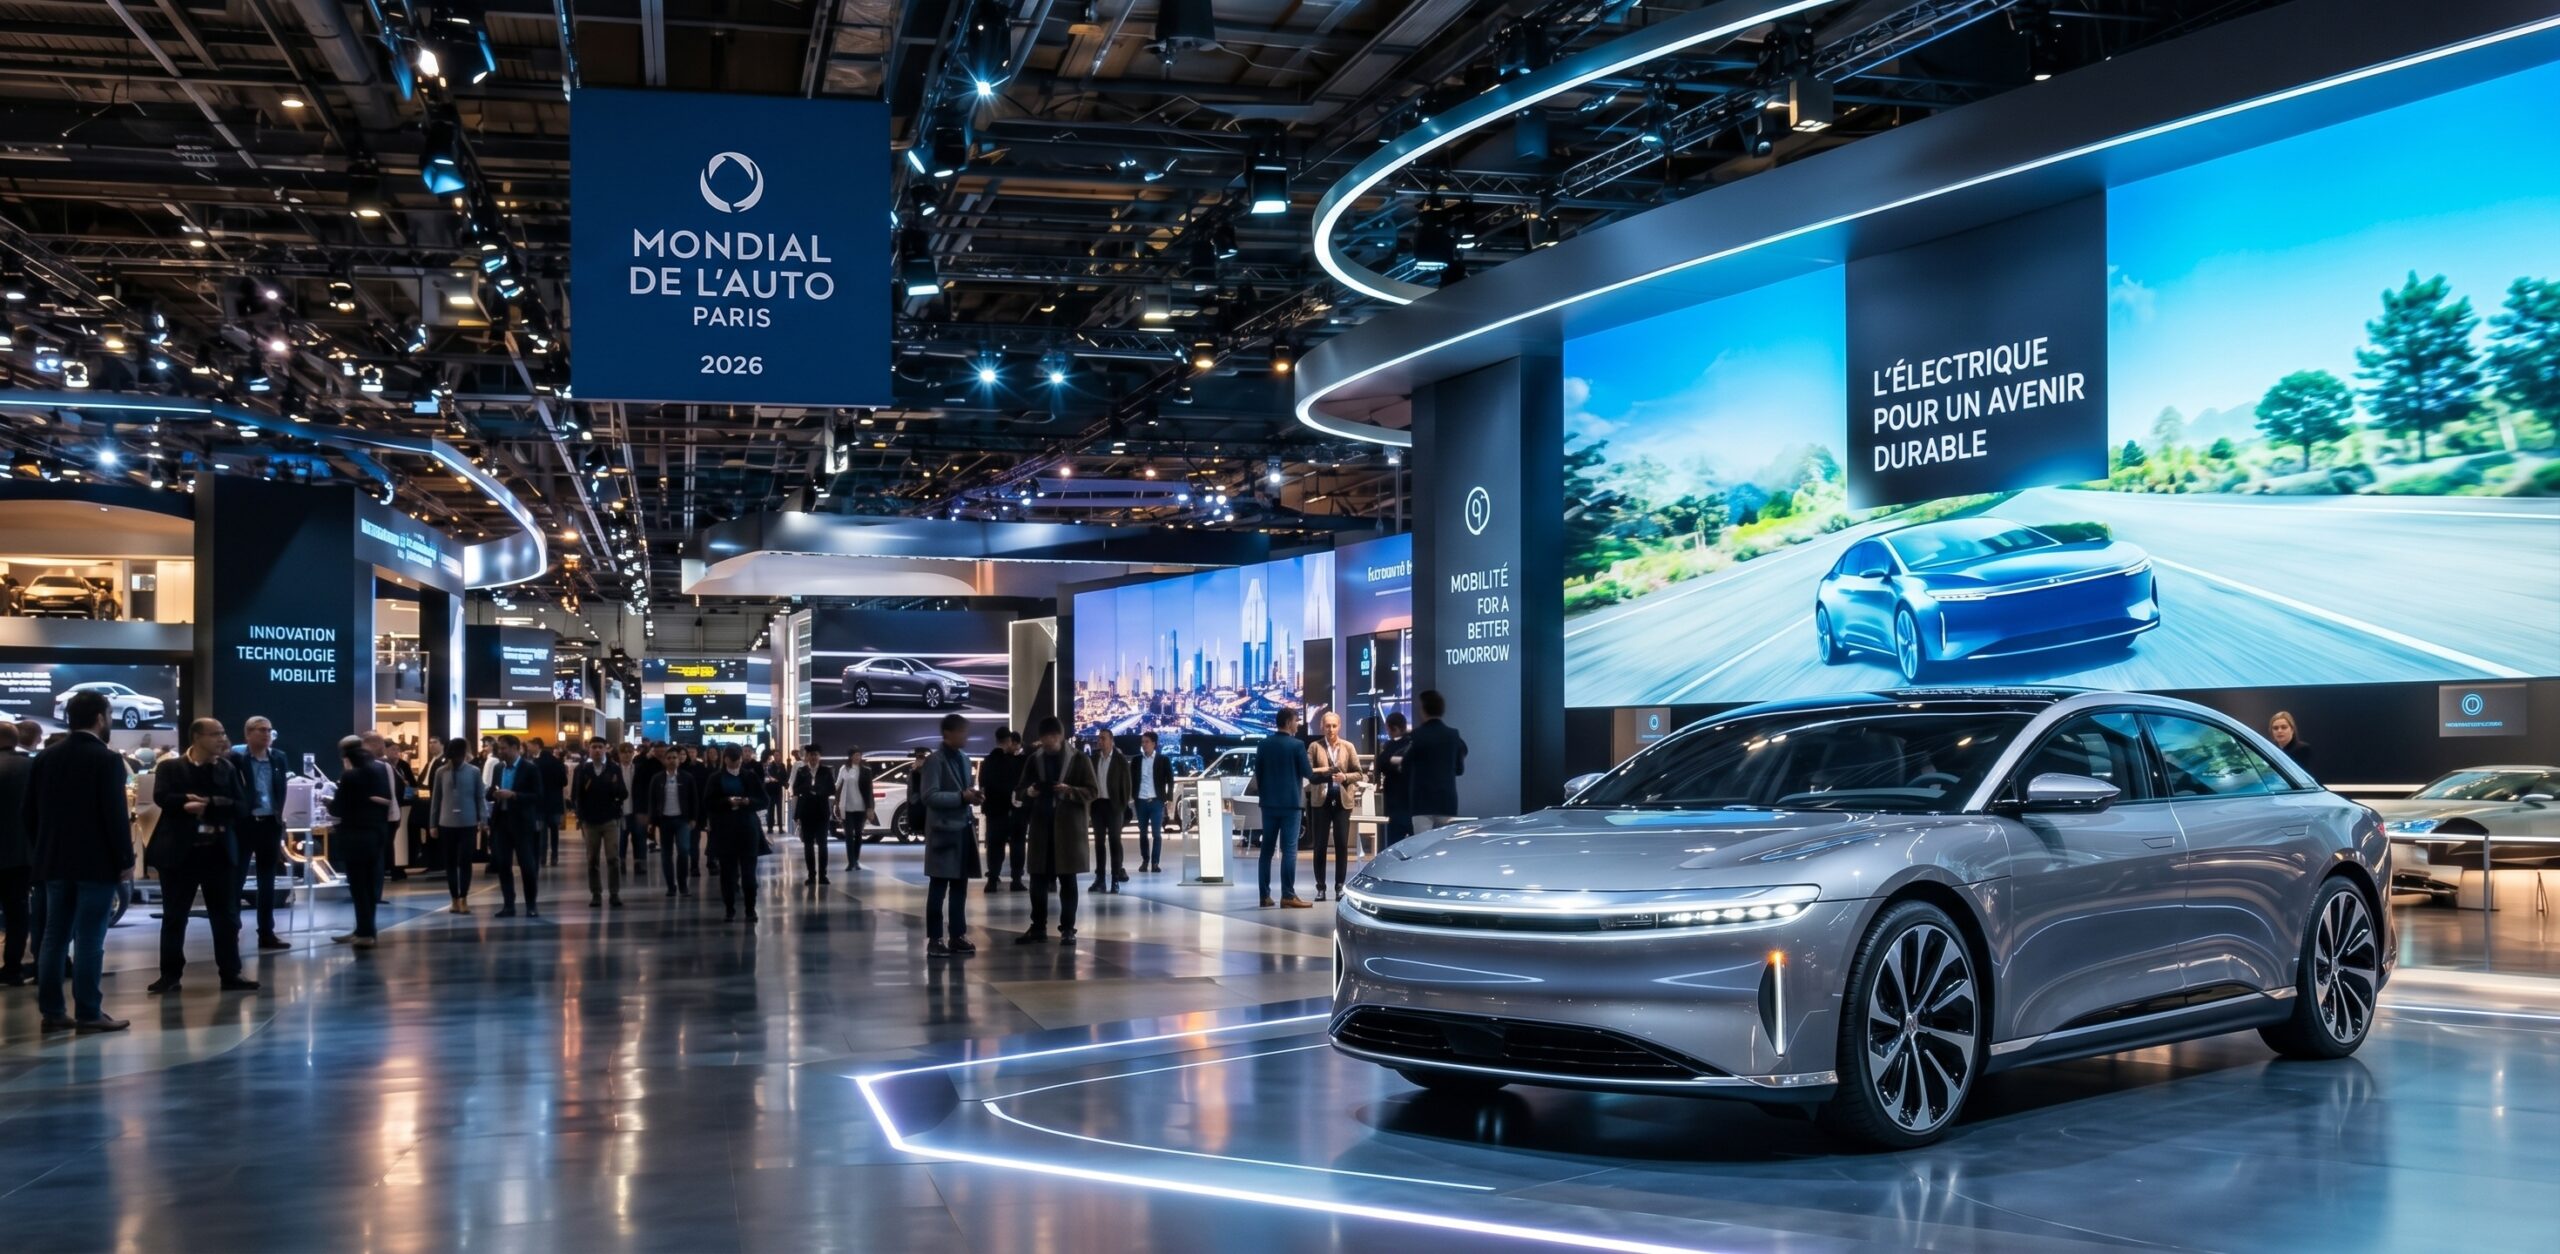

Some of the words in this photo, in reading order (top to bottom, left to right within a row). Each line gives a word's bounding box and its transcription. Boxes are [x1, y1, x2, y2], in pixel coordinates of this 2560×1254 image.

[633, 228, 832, 263] MONDIAL
[630, 267, 682, 296] DE
[698, 268, 835, 301] L'AUTO
[693, 307, 771, 328] PARIS
[700, 355, 763, 375] 2026
[1874, 336, 2049, 397] L'ÉLECTRIQUE
[1874, 398, 1939, 434] POUR
[1946, 390, 1981, 422] UN
[1987, 372, 2085, 416] AVENIR
[1874, 429, 1988, 472] DURABLE
[1451, 561, 1509, 593] MOBILITÉ
[1477, 597, 1500, 615] FOR
[1500, 595, 1510, 612] A
[250, 625, 336, 642] INNOVATION
[1467, 619, 1510, 640] BETTER
[236, 646, 336, 663] TECHNOLOGIE
[1445, 644, 1510, 666] TOMORROW
[270, 667, 336, 683] MOBILITÉ
